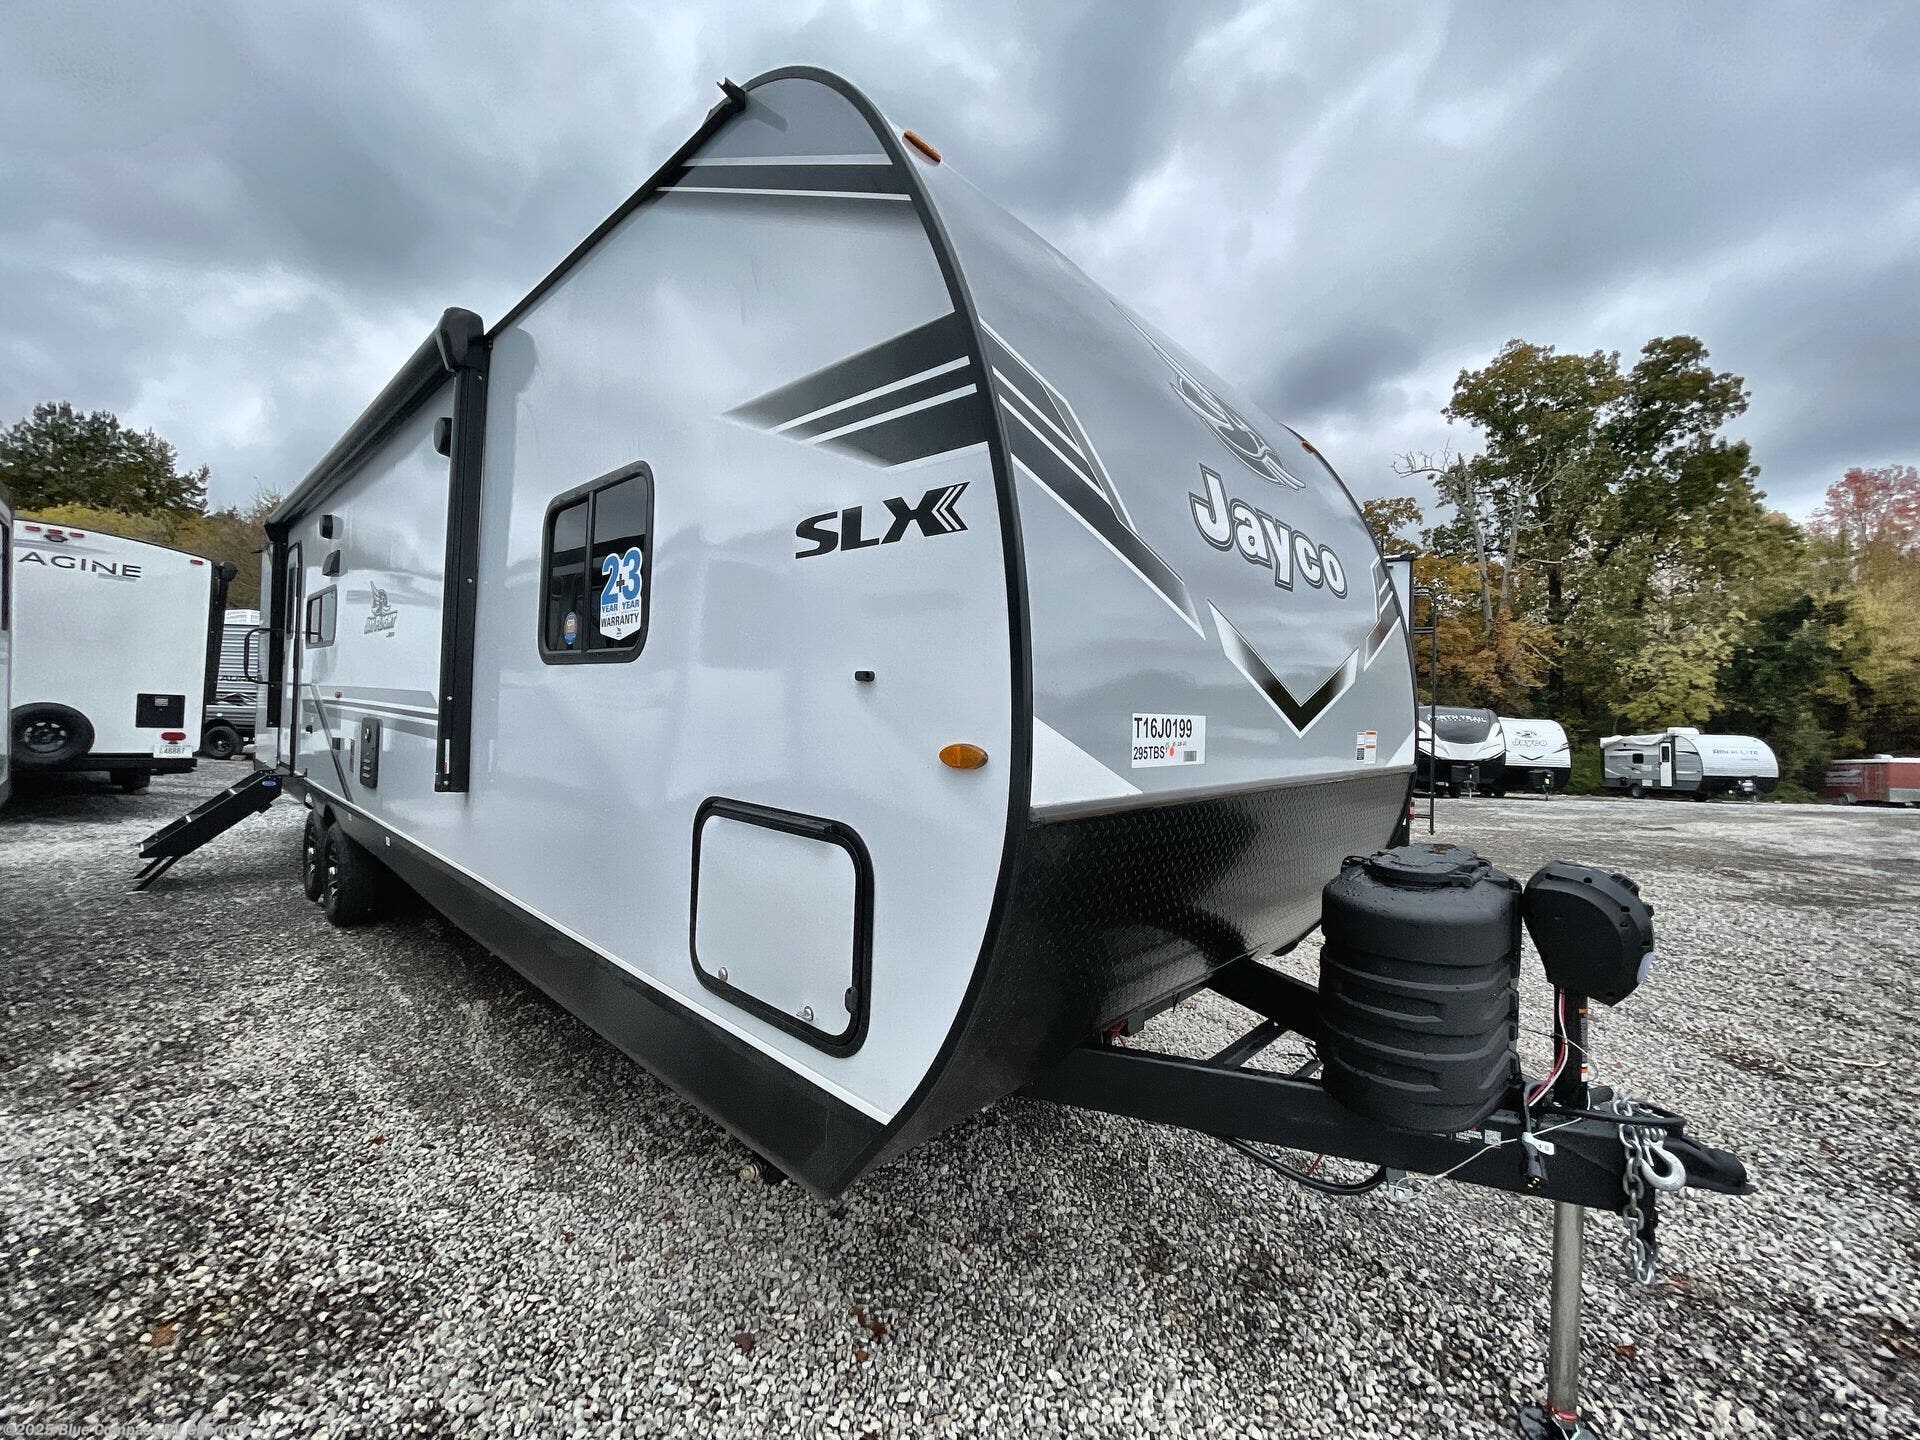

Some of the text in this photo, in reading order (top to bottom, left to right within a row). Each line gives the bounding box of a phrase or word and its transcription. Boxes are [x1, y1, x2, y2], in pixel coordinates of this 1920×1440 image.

[795, 481, 970, 559] SLX
[1188, 462, 1348, 600] Jayco
[18, 551, 141, 578] AGINE
[602, 604, 618, 613] YEAR
[622, 600, 639, 610] YEAR
[601, 613, 639, 628] WARRANTY
[1134, 717, 1192, 738] T16J0199
[1512, 739, 1548, 747] Jayco
